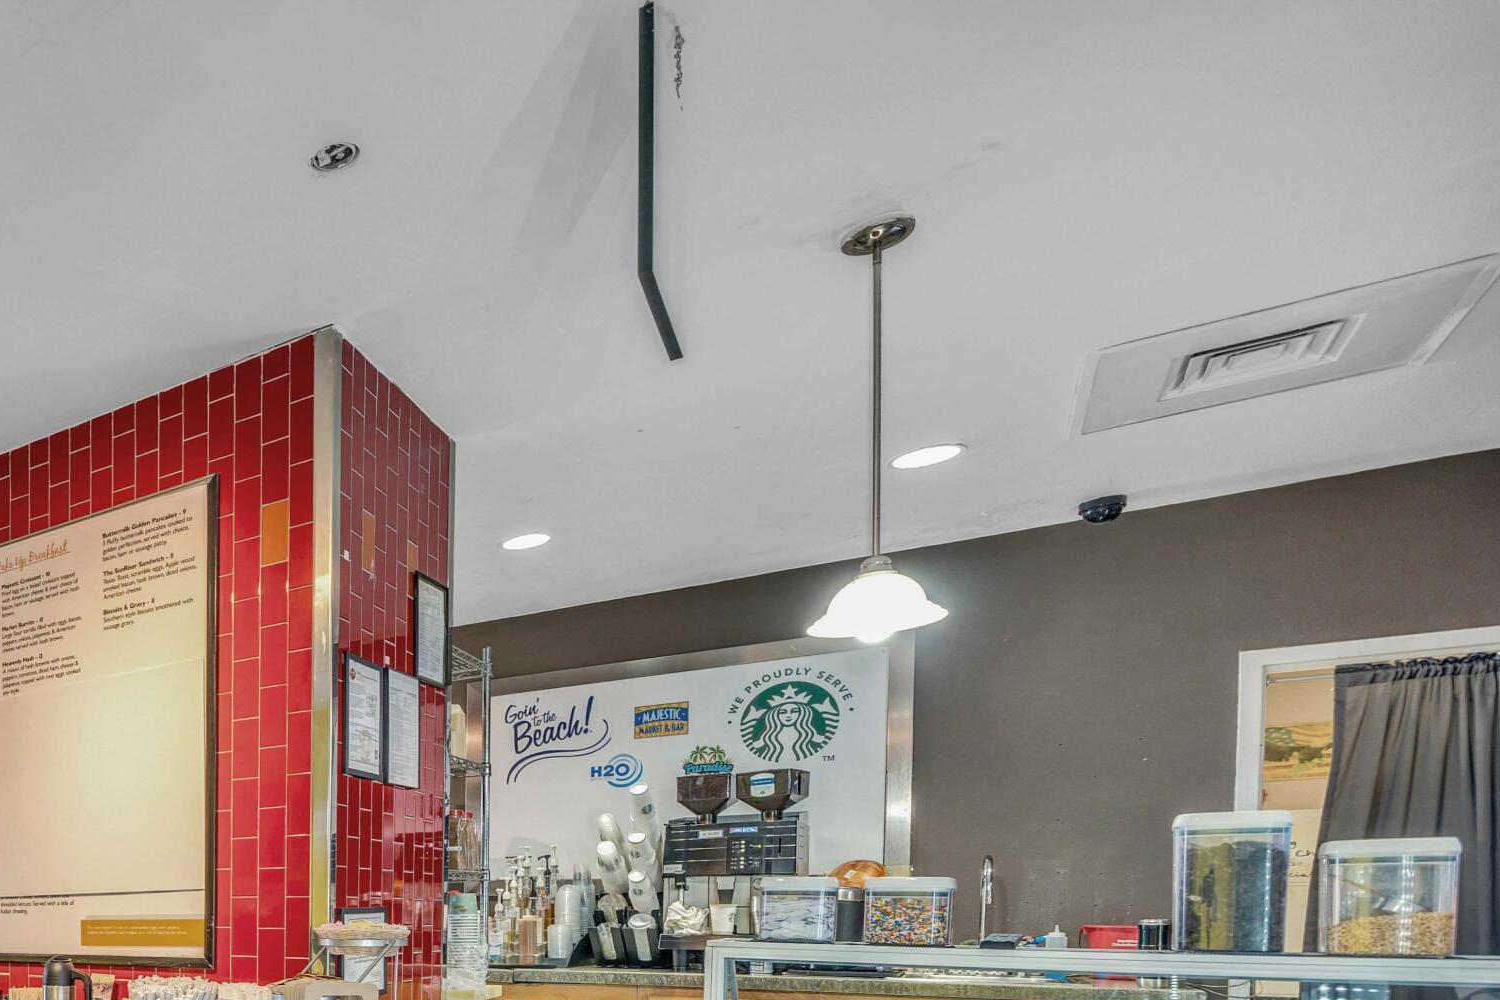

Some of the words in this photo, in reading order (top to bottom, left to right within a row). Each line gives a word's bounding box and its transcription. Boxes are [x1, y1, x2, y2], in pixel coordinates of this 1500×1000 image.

[103, 526, 130, 539] Buttermilk
[132, 520, 150, 530] Golden
[152, 512, 177, 524] Pancakes
[138, 556, 164, 567] Sandwich
[728, 697, 744, 714] WE
[745, 668, 811, 694] PROUDLY
[817, 671, 853, 700] SERVE
[505, 697, 539, 724] Goin'
[532, 717, 541, 726] to
[543, 710, 557, 723] the
[642, 709, 680, 724] MAJESTIC
[514, 696, 594, 754] Beach!
[639, 725, 662, 735] MARKET
[672, 722, 684, 731] BAR
[591, 764, 630, 777] H2O
[684, 762, 734, 774] Paradise
